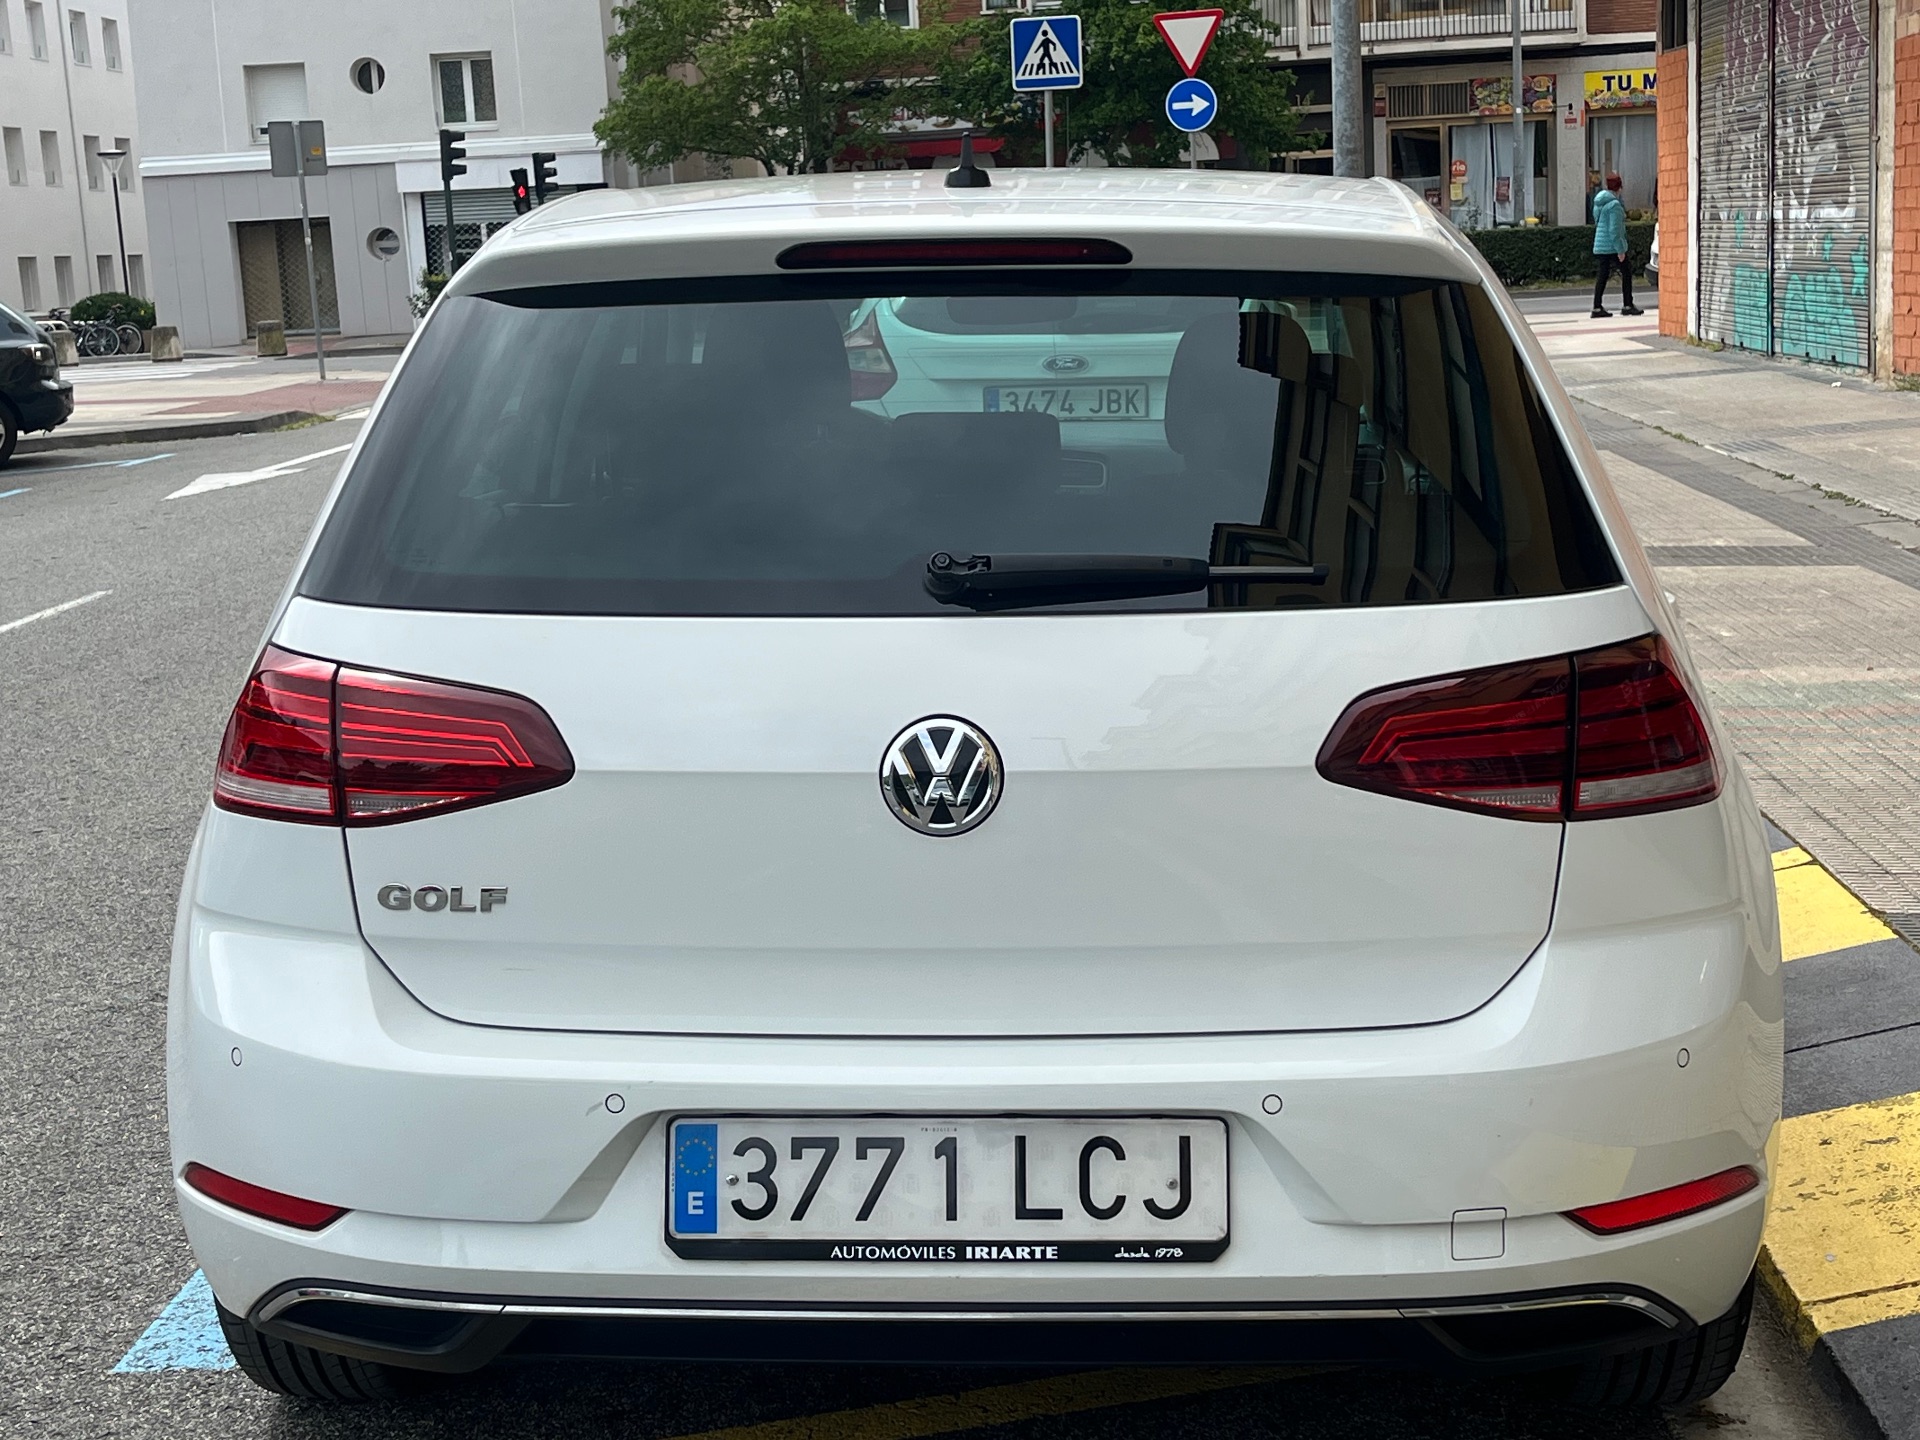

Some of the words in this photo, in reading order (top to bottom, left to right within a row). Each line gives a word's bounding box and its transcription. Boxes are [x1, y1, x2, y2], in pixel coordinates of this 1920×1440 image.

[1602, 74, 1632, 92] TU
[1053, 358, 1079, 370] Ford
[1005, 389, 1075, 415] 3474
[1089, 389, 1140, 415] JBK
[377, 882, 509, 913] GOLF
[730, 1136, 958, 1222] 3771
[1015, 1135, 1192, 1221] LCJ
[687, 1191, 705, 1215] E
[830, 1244, 956, 1260] AUTOMÓVILES
[965, 1246, 1059, 1260] IRIARTE
[1114, 1246, 1151, 1258] desde
[1154, 1247, 1184, 1258] 1978
